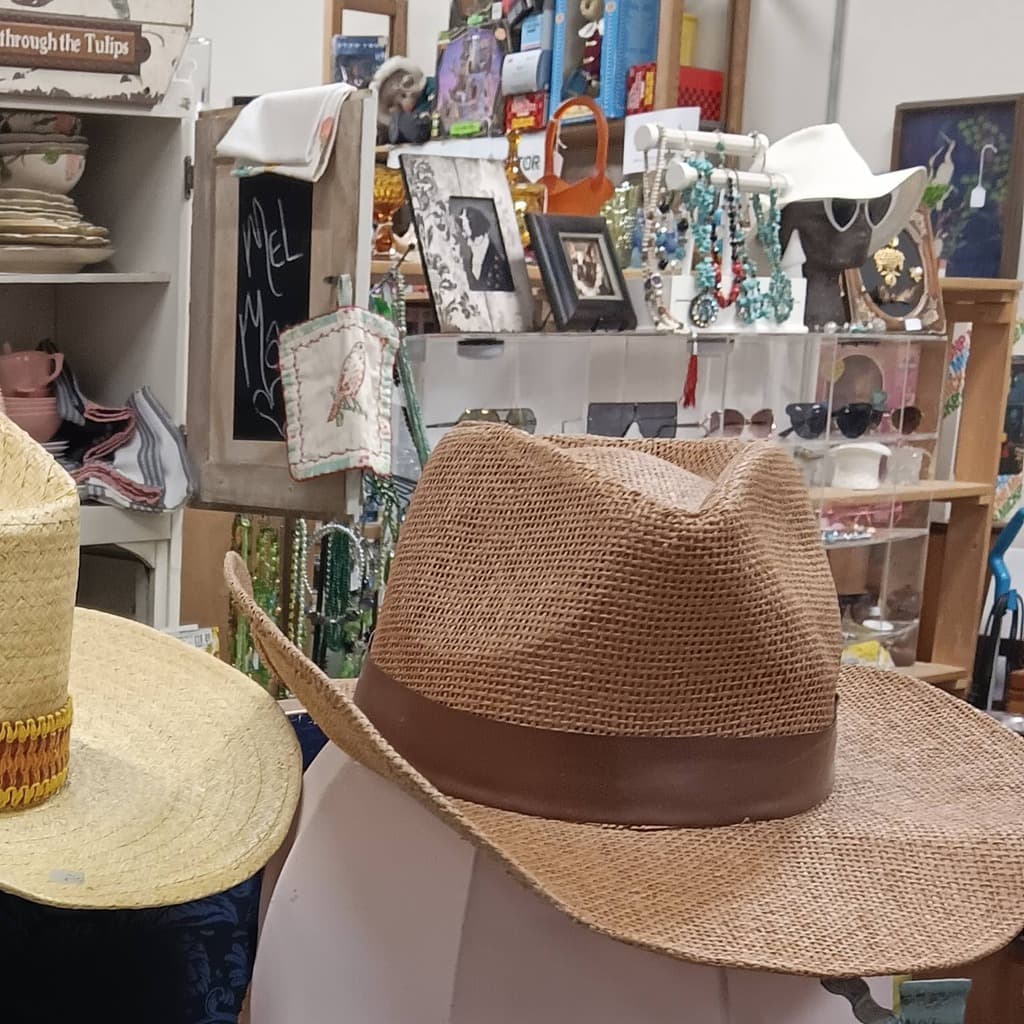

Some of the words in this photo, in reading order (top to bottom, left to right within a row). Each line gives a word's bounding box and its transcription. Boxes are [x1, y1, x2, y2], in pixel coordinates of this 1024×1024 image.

[0, 29, 57, 55] through
[59, 33, 81, 53] the
[84, 32, 130, 59] Tulips
[243, 197, 304, 297] MEL
